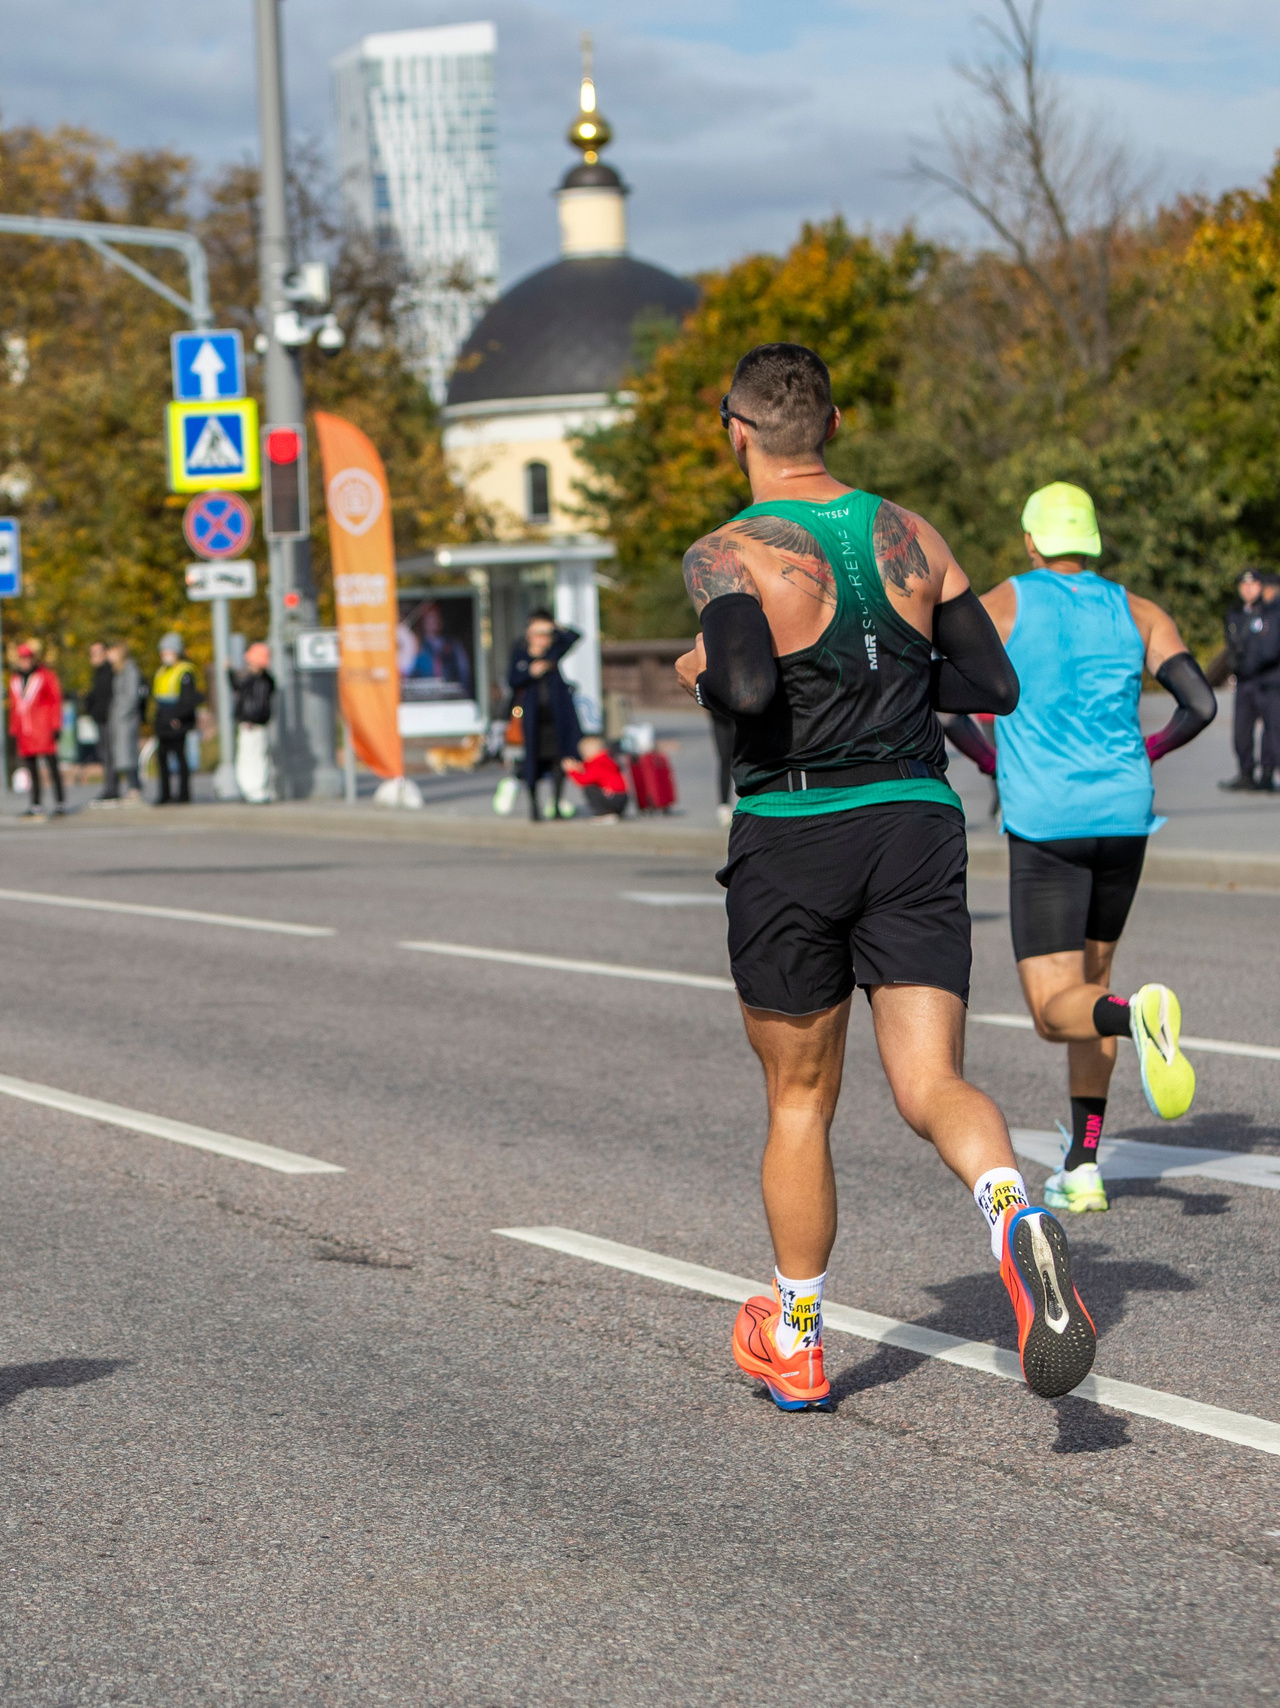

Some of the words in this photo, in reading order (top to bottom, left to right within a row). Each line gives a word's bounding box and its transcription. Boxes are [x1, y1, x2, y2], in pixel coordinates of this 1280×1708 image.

[864, 634, 878, 670] MIR
[1082, 1114, 1103, 1149] RUN
[783, 1310, 820, 1332] СИЛА
